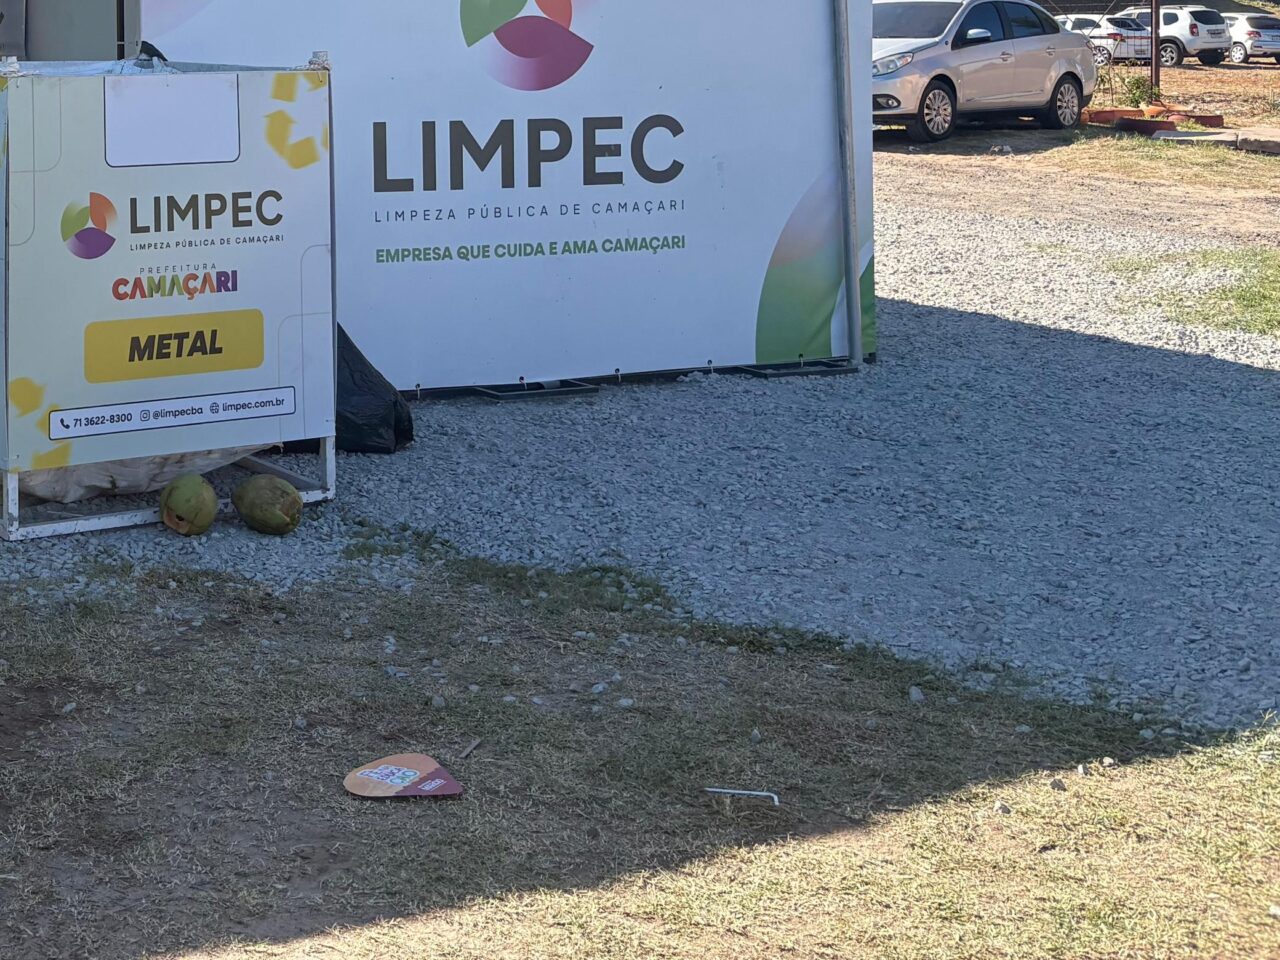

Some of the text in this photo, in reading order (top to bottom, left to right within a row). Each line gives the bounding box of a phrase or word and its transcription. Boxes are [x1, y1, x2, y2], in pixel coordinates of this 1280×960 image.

[372, 113, 685, 192] LIMPEC
[130, 190, 283, 234] LIMPEC
[374, 199, 685, 223] LIMPEZA PÚBLICA DE CAMAÇARI
[129, 234, 284, 251] LIMPEZA PÚBLICA DE CAMAÇARI
[375, 235, 686, 263] EMPRESA QUE CUIDA E AMA CAMAÇARI
[139, 263, 217, 275] PREFEITURA
[112, 270, 238, 300] CAMAÇARI
[128, 329, 223, 362] METAL
[73, 396, 285, 428] 71 3622-8300 @limpecba limpec.com.br
